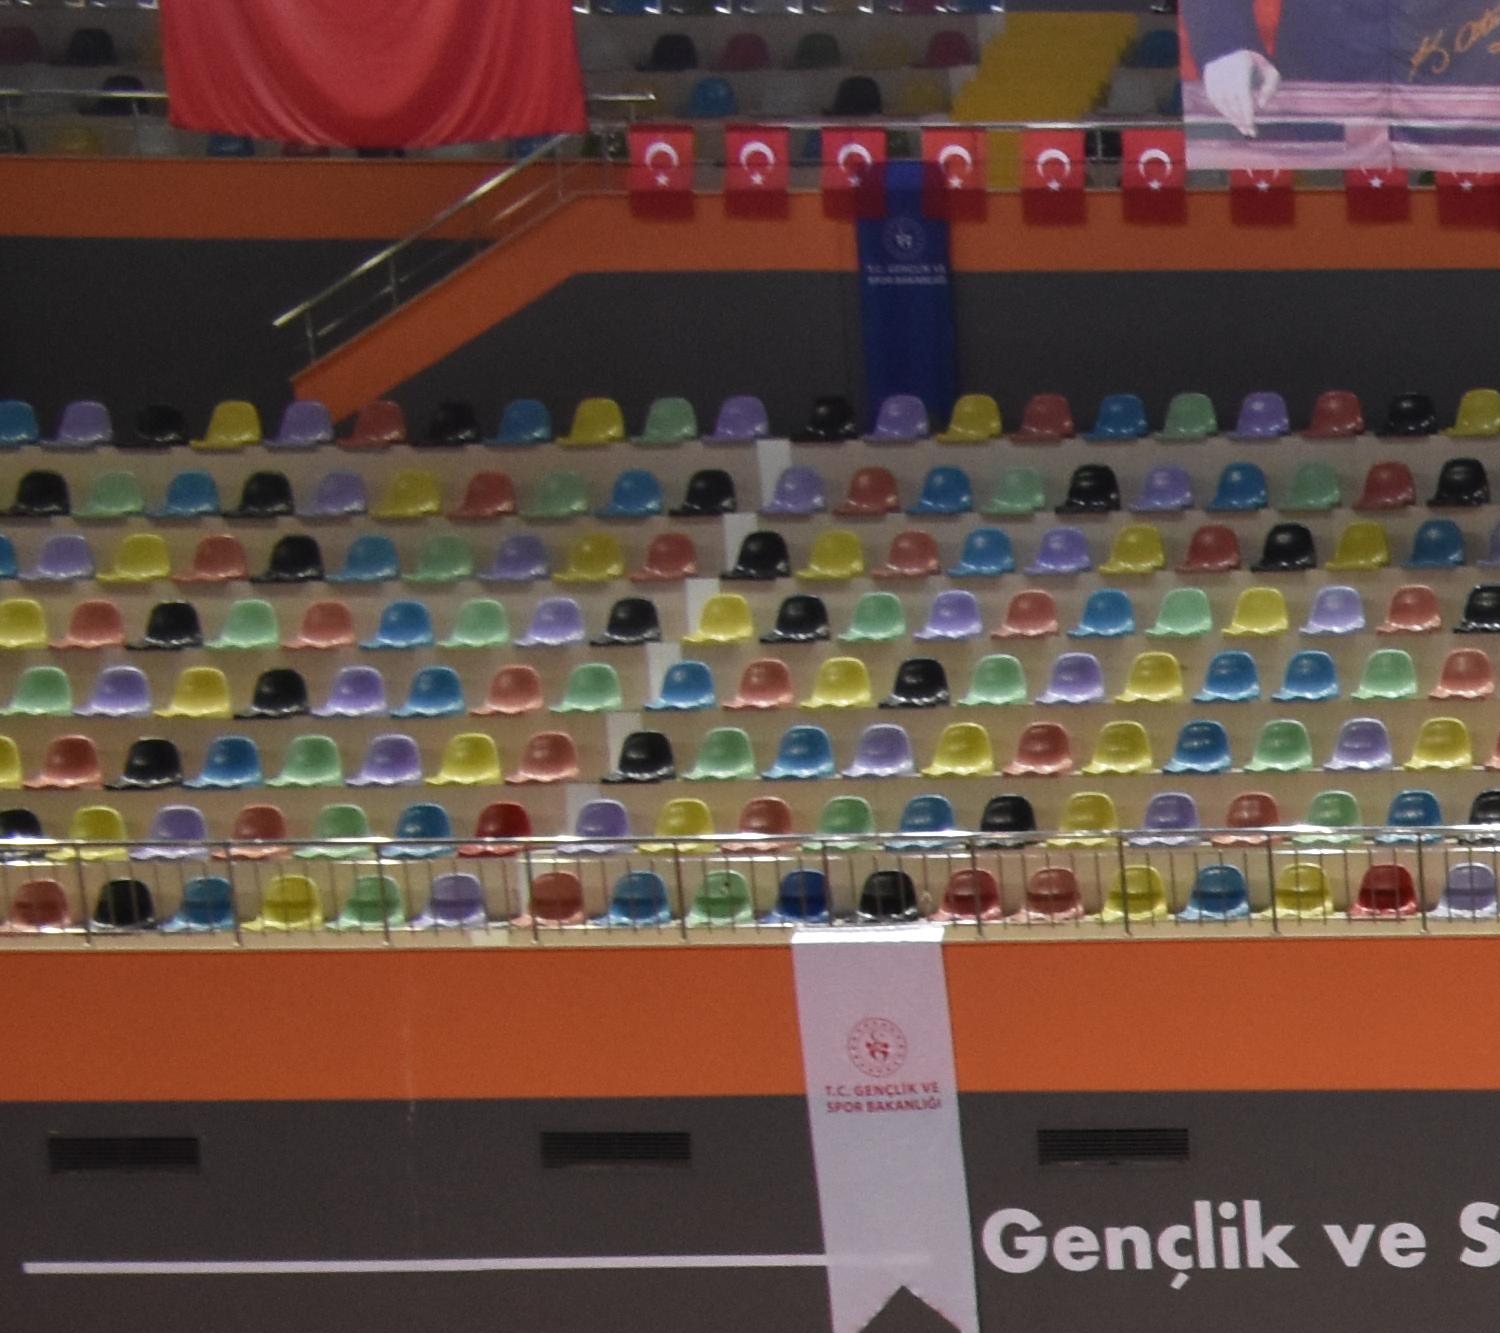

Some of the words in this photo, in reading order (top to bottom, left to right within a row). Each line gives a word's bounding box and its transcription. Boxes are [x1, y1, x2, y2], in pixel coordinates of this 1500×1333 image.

[922, 1081, 940, 1094] VE
[826, 1101, 863, 1113] SPOR
[981, 1199, 1300, 1290] Gençlik
[1323, 1222, 1427, 1269] ve
